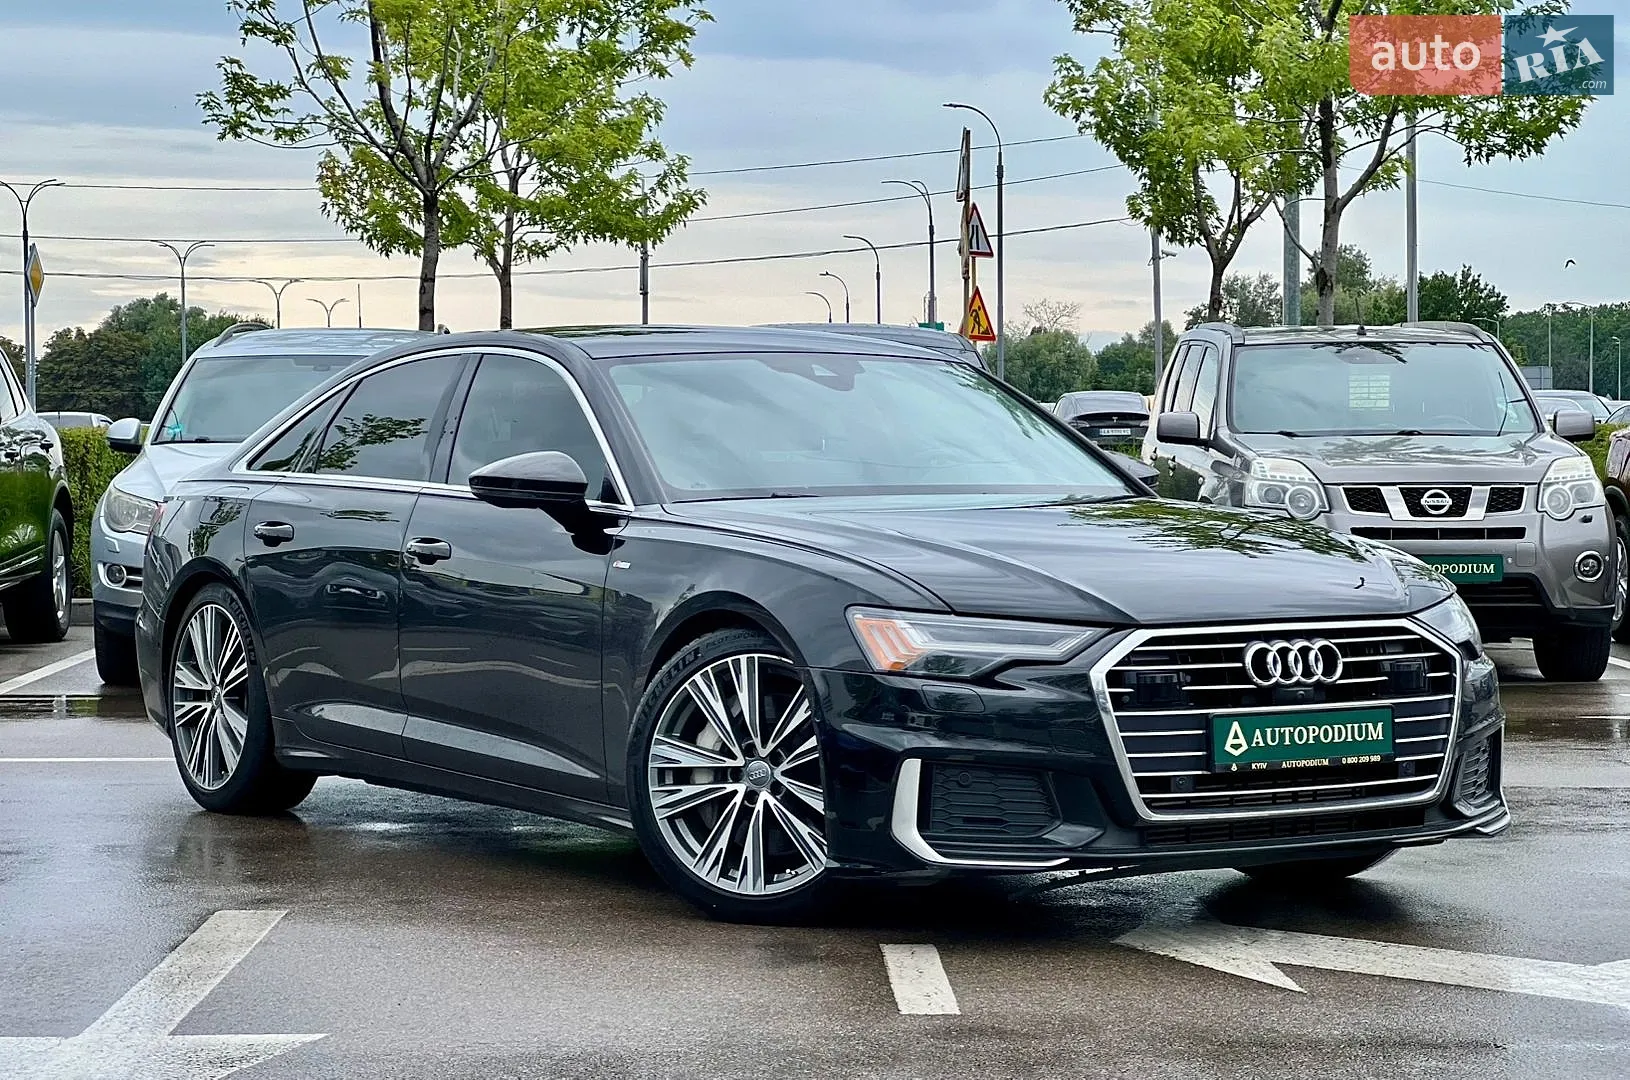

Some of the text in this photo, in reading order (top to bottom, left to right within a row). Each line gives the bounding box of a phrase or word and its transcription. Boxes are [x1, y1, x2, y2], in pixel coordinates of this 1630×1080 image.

[1430, 563, 1496, 574] OPODIUM
[1251, 721, 1384, 748] AUTOPODIUM
[1251, 762, 1268, 770] KYIV
[1281, 758, 1329, 769] AUTOPODIUM
[1346, 756, 1358, 764] 800
[1358, 755, 1370, 764] 209
